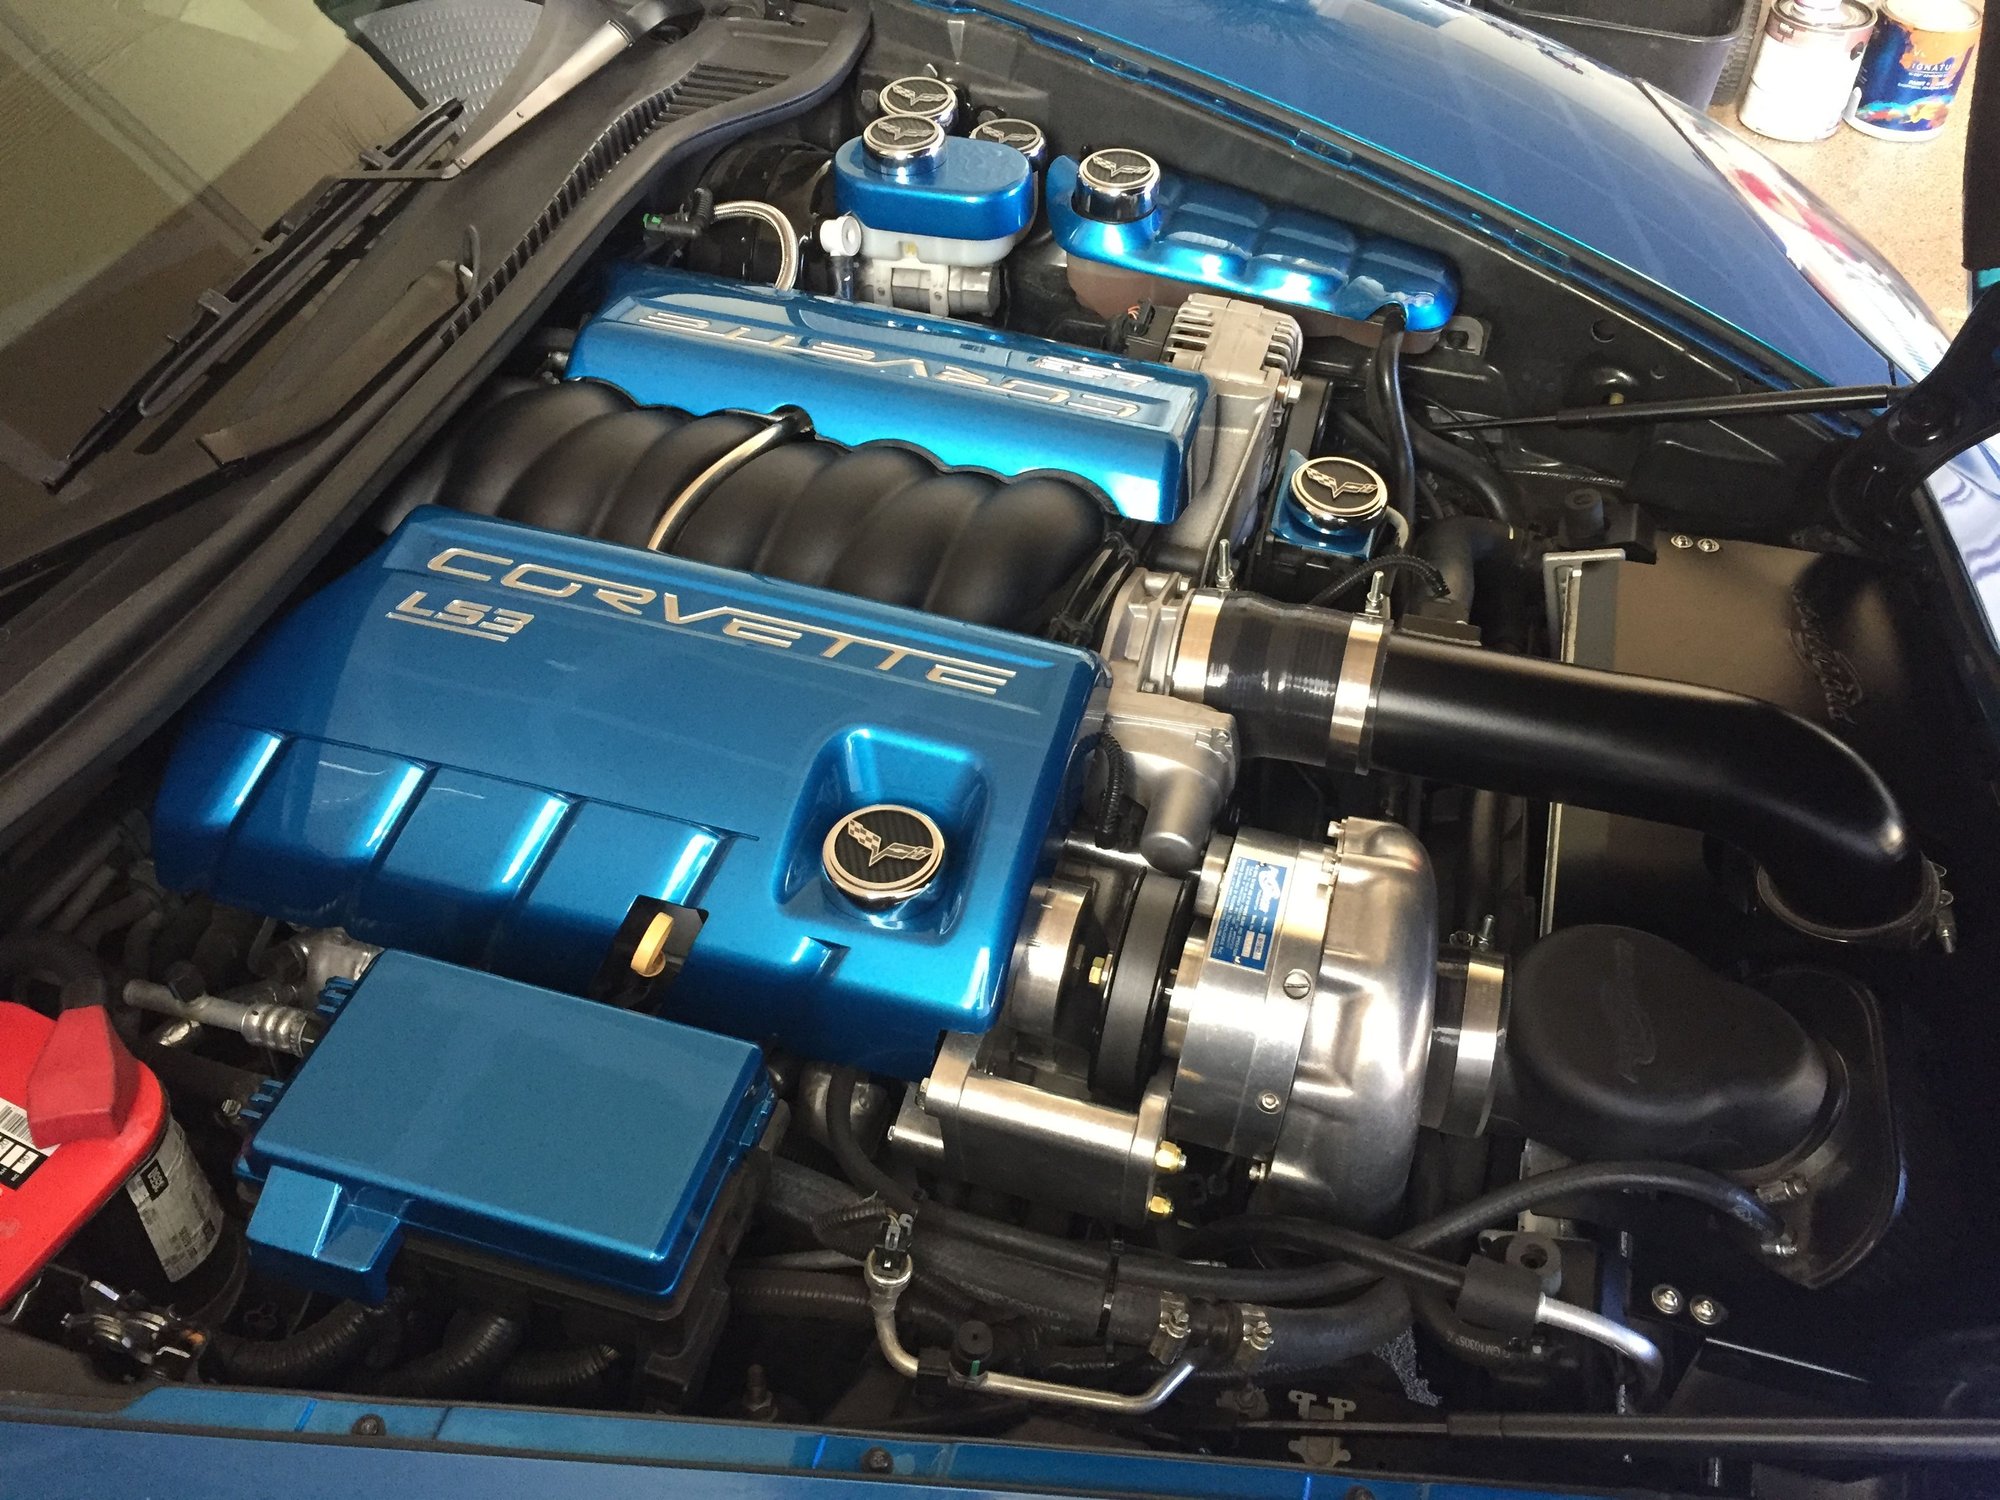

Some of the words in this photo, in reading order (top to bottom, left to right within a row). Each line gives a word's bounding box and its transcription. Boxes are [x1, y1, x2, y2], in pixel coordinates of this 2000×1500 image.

[638, 311, 1139, 417] CORVETTE
[394, 591, 535, 635] LS3
[427, 548, 1016, 694] CORVETTE
